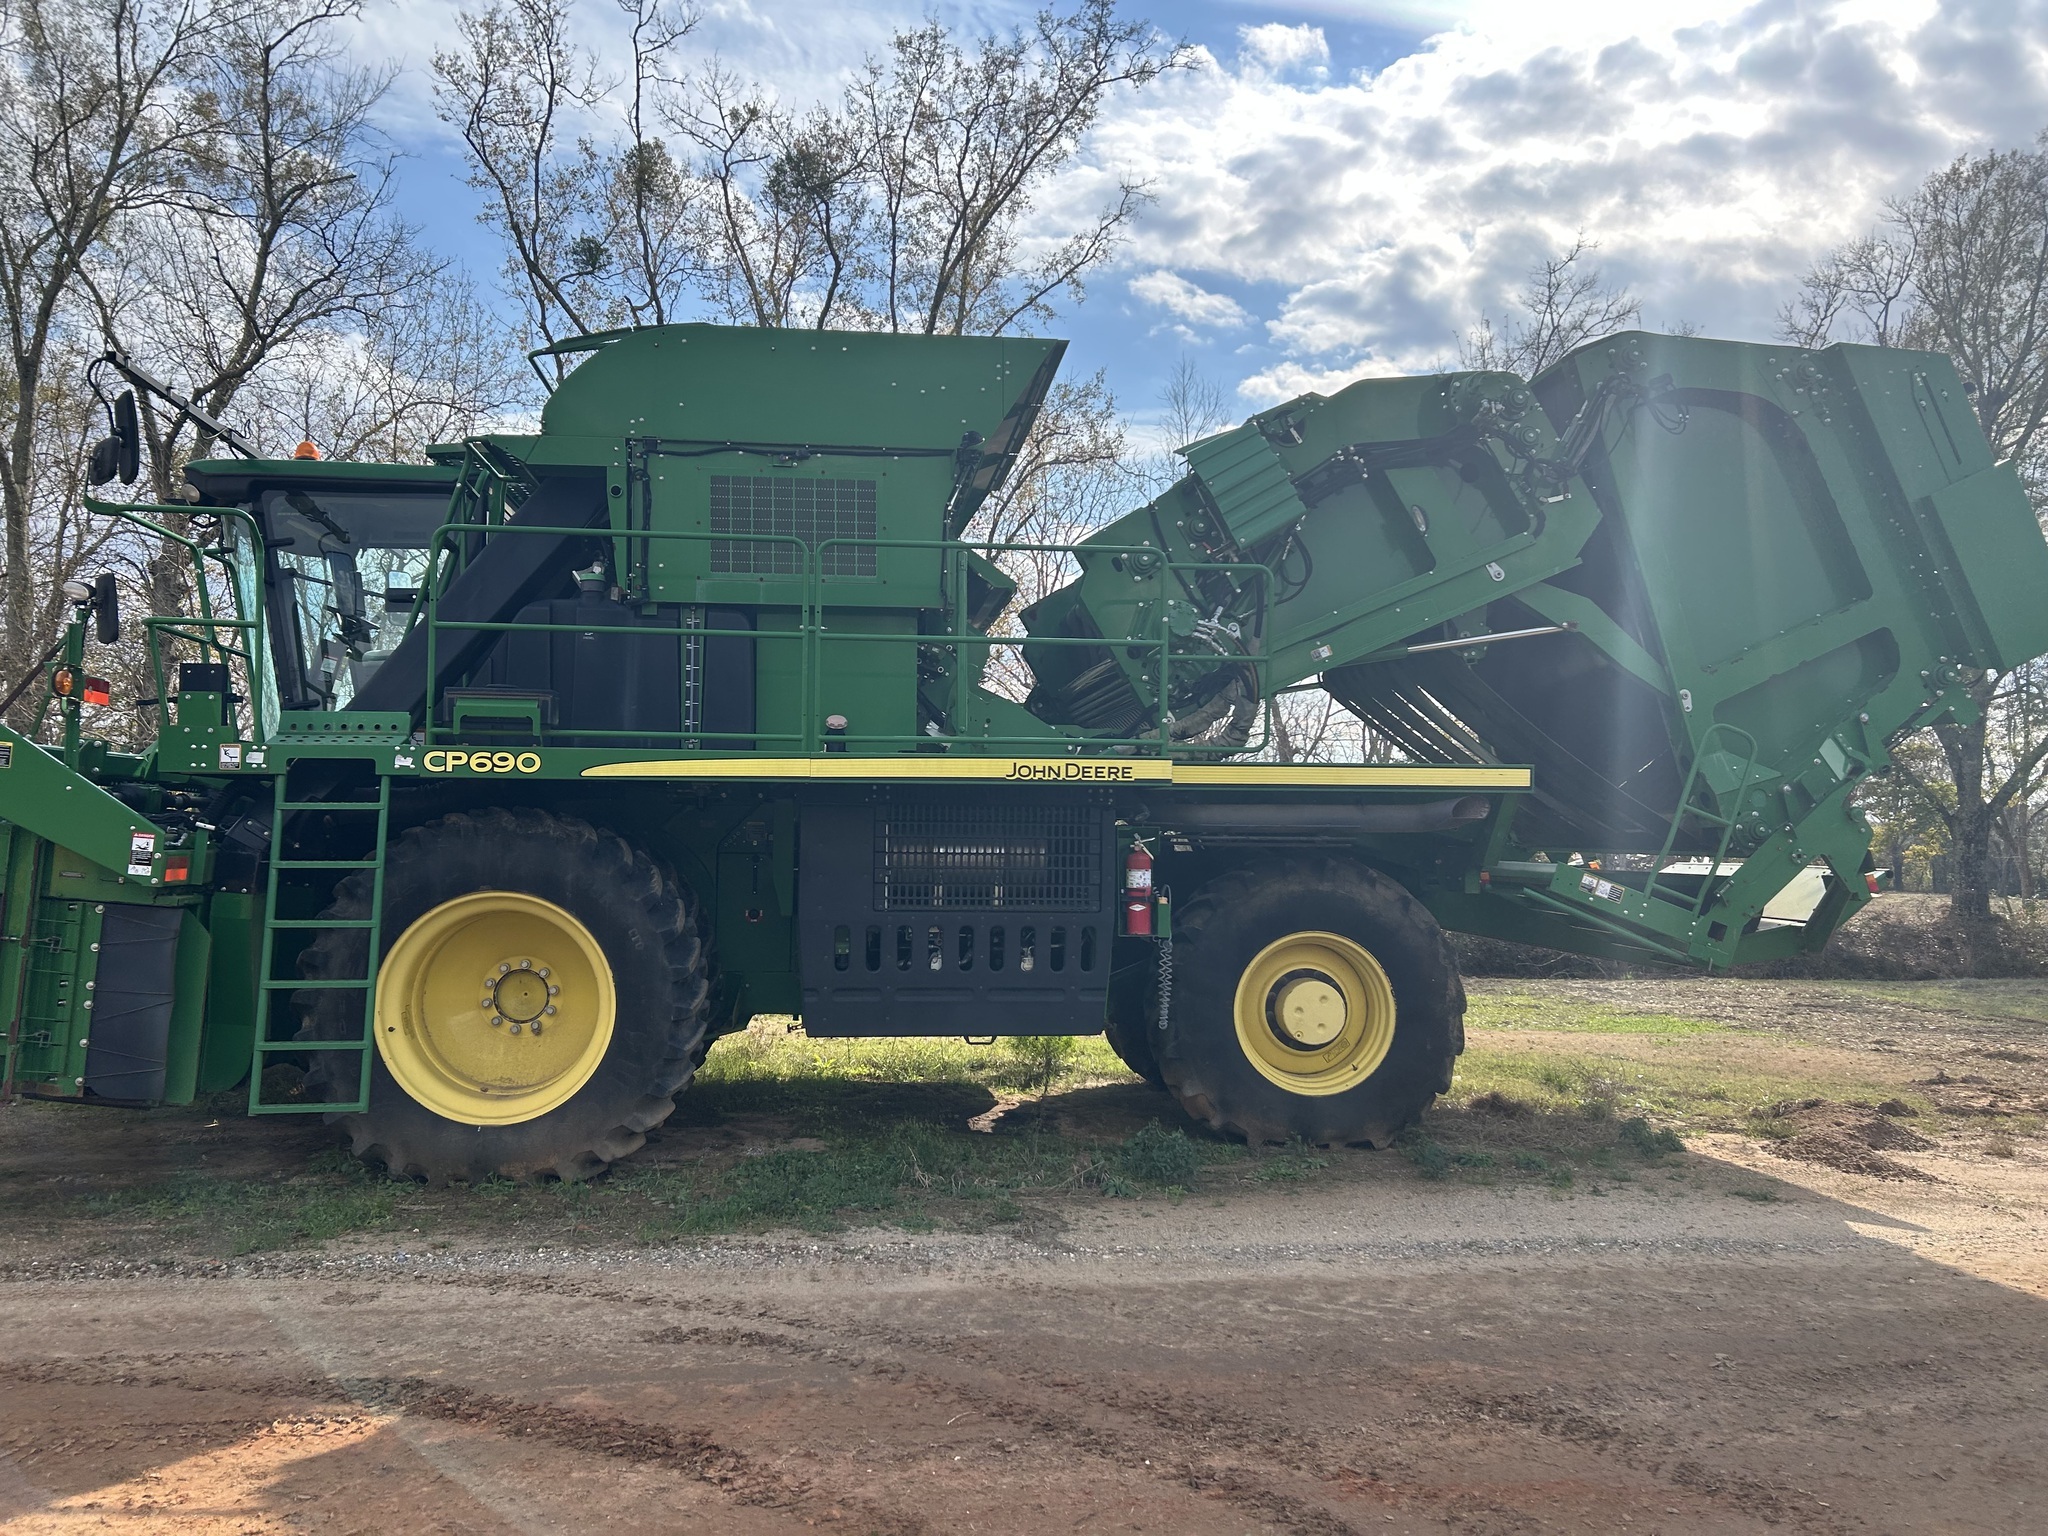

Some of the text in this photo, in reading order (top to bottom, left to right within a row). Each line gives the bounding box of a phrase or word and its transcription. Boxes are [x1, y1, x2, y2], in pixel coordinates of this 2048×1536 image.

[423, 751, 541, 773] CP690
[1005, 762, 1133, 778] JOHN DEERE
